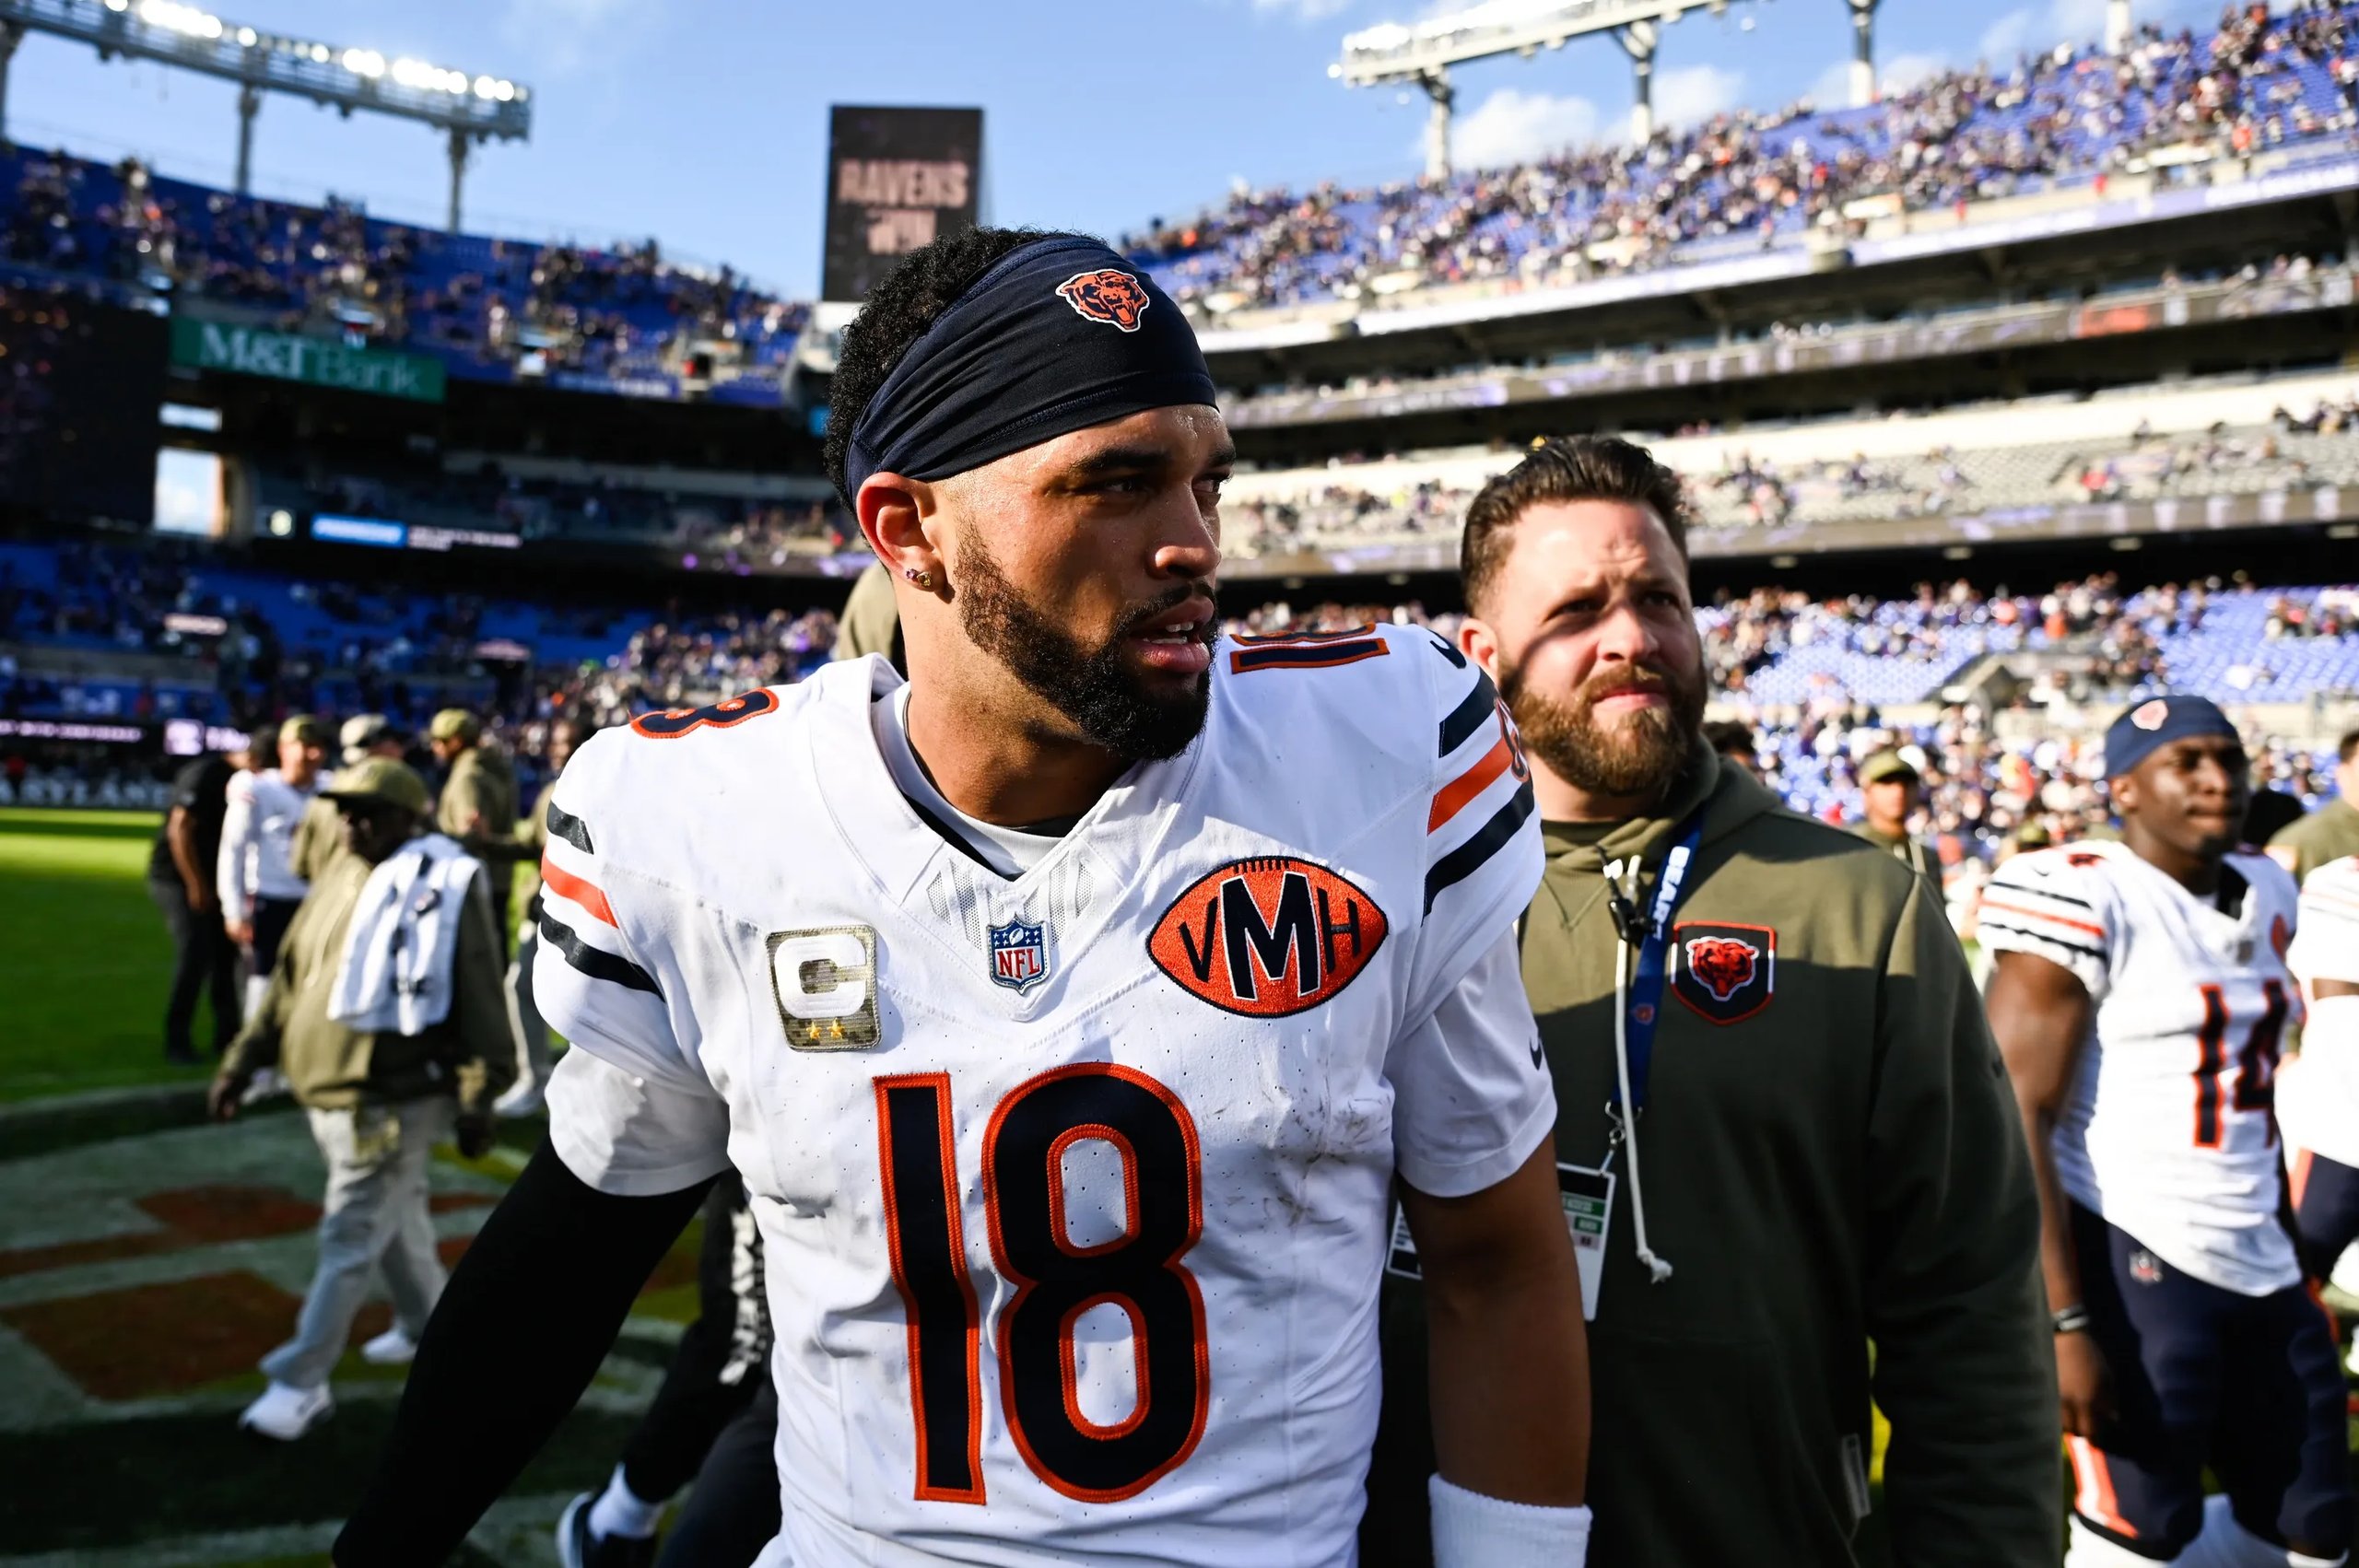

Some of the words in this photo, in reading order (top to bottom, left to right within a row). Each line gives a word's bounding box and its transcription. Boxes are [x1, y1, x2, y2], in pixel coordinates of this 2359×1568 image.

[838, 158, 969, 208] RAVENS
[200, 323, 310, 380] M&T
[317, 344, 421, 393] Bank
[773, 932, 867, 1020] C
[996, 948, 1041, 980] NFL
[1179, 870, 1361, 1001] VMH
[2189, 977, 2290, 1150] 14
[873, 1062, 1210, 1505] 18
